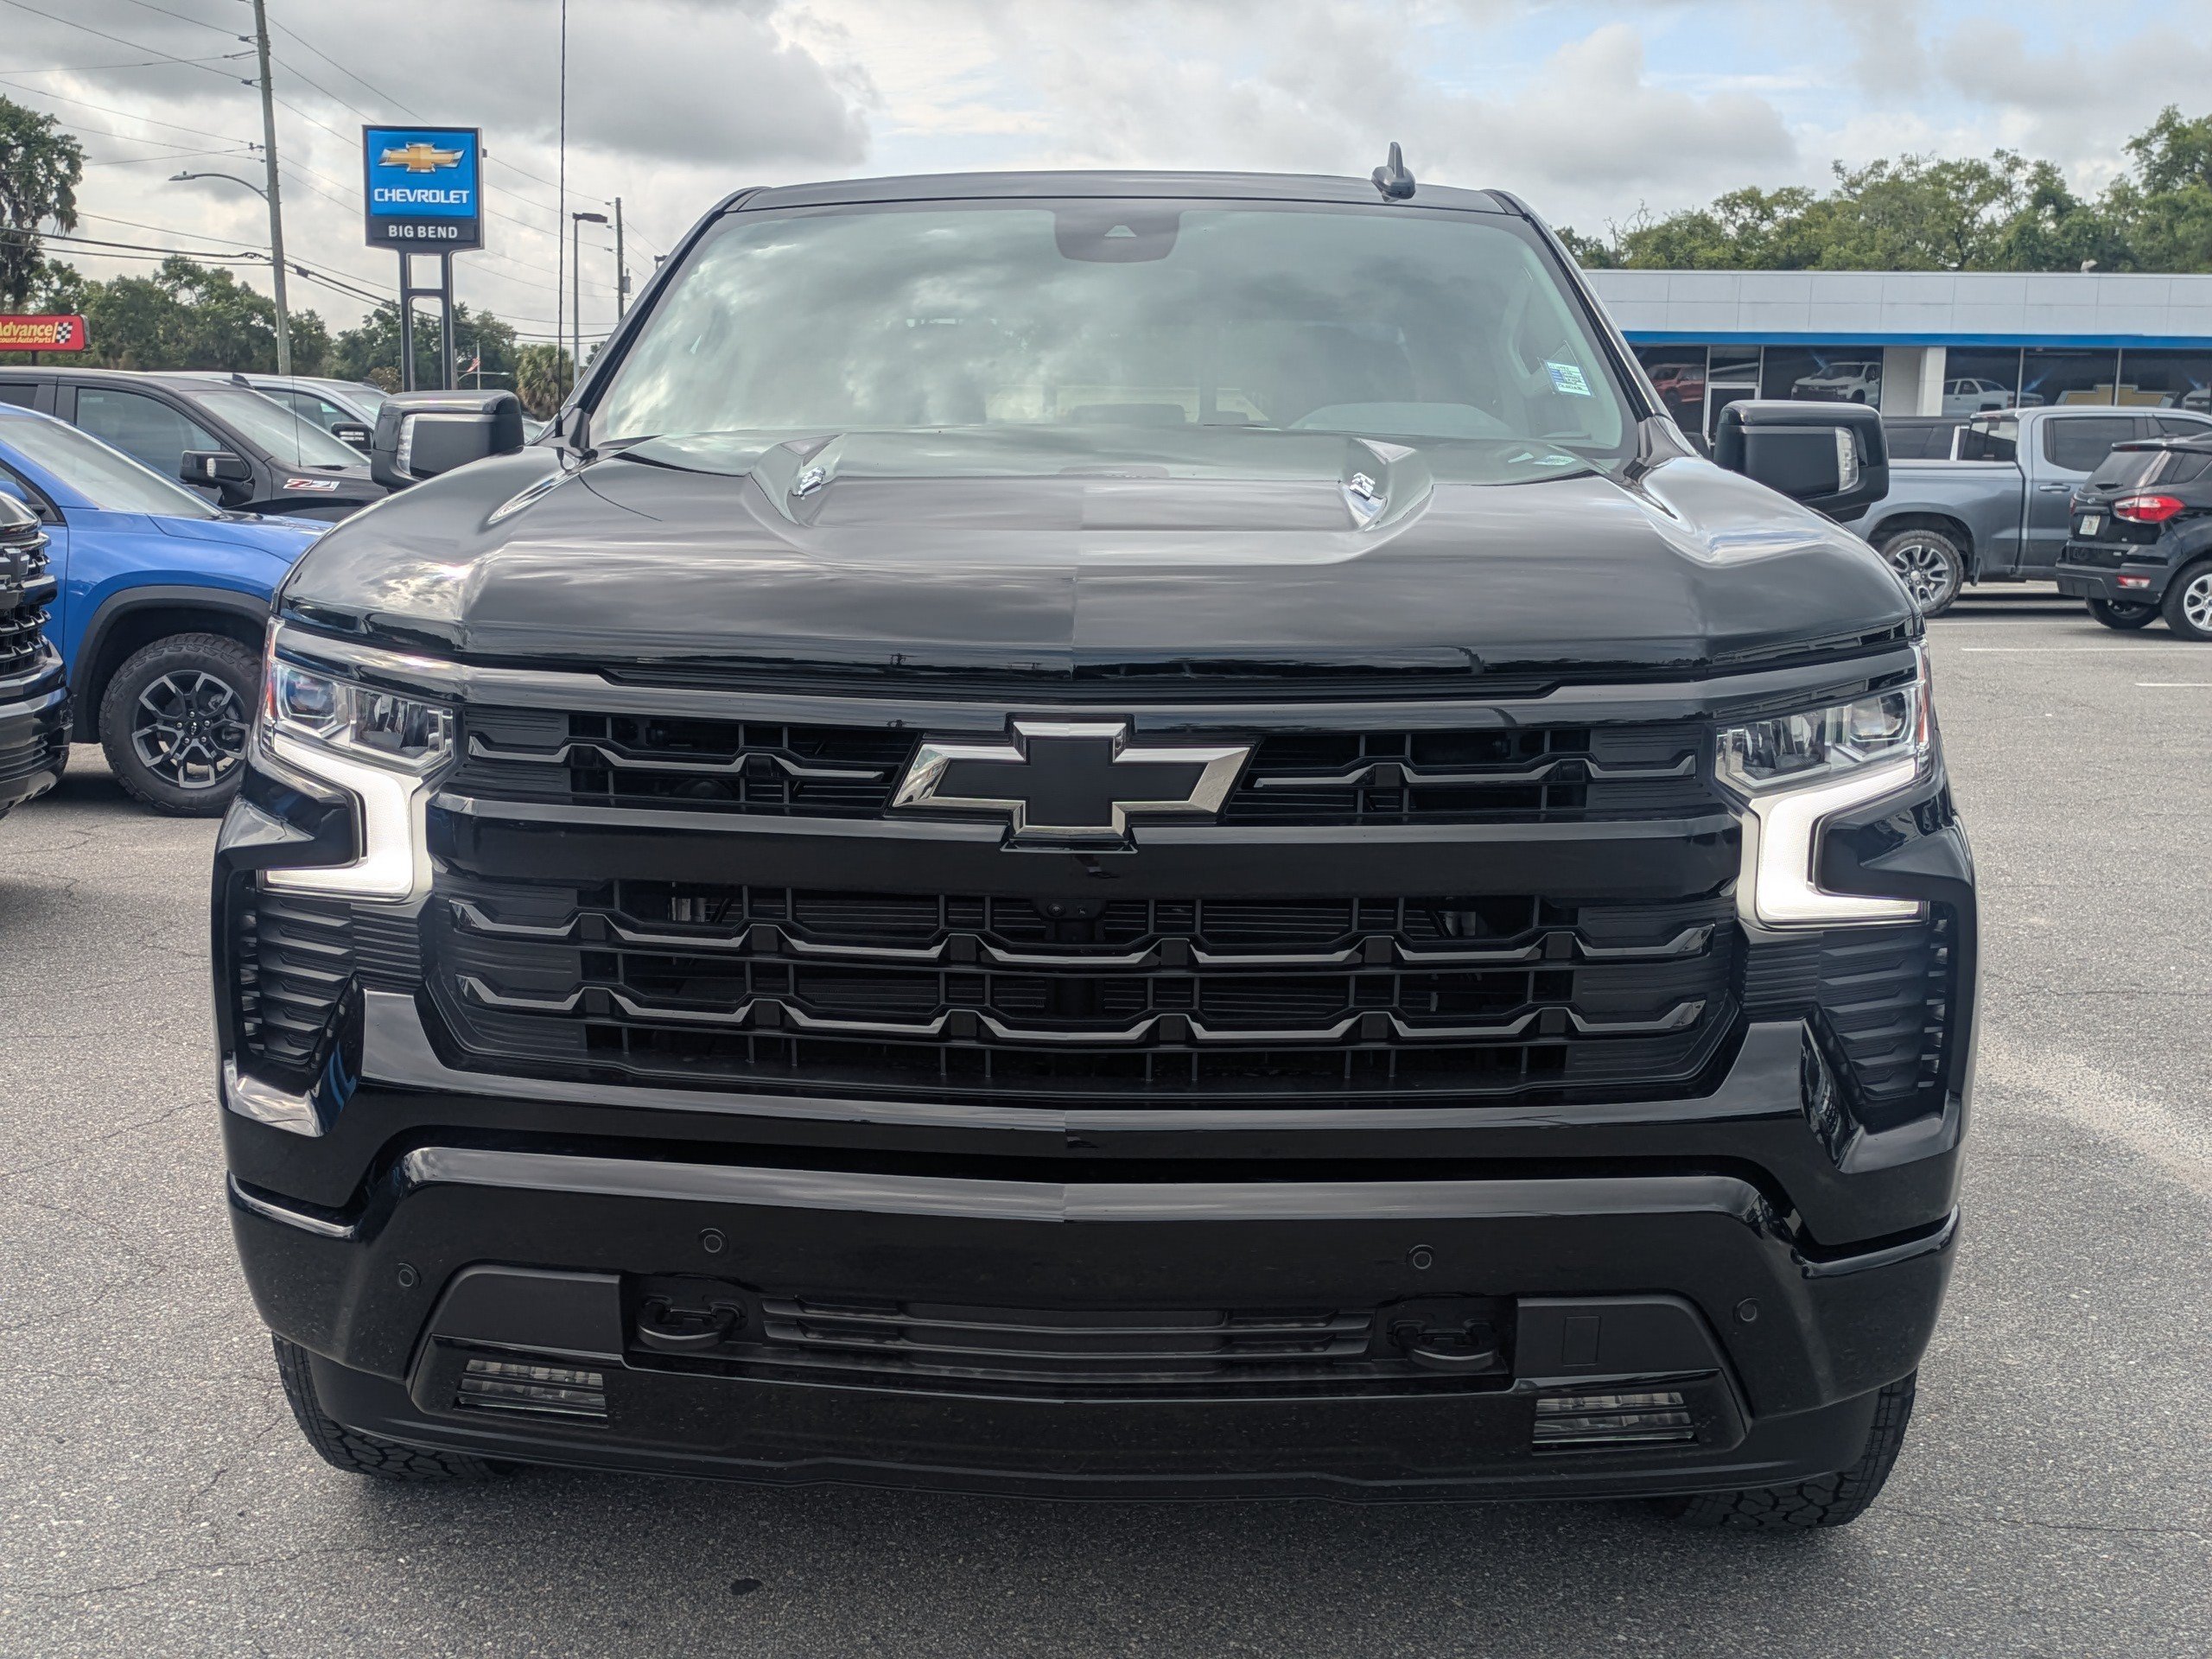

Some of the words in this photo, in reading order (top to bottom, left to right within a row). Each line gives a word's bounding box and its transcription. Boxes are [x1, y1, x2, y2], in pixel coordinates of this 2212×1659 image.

[373, 188, 469, 204] CHEVROLET
[388, 225, 414, 238] BIG
[417, 226, 458, 238] BEND
[0, 321, 54, 336] dvance
